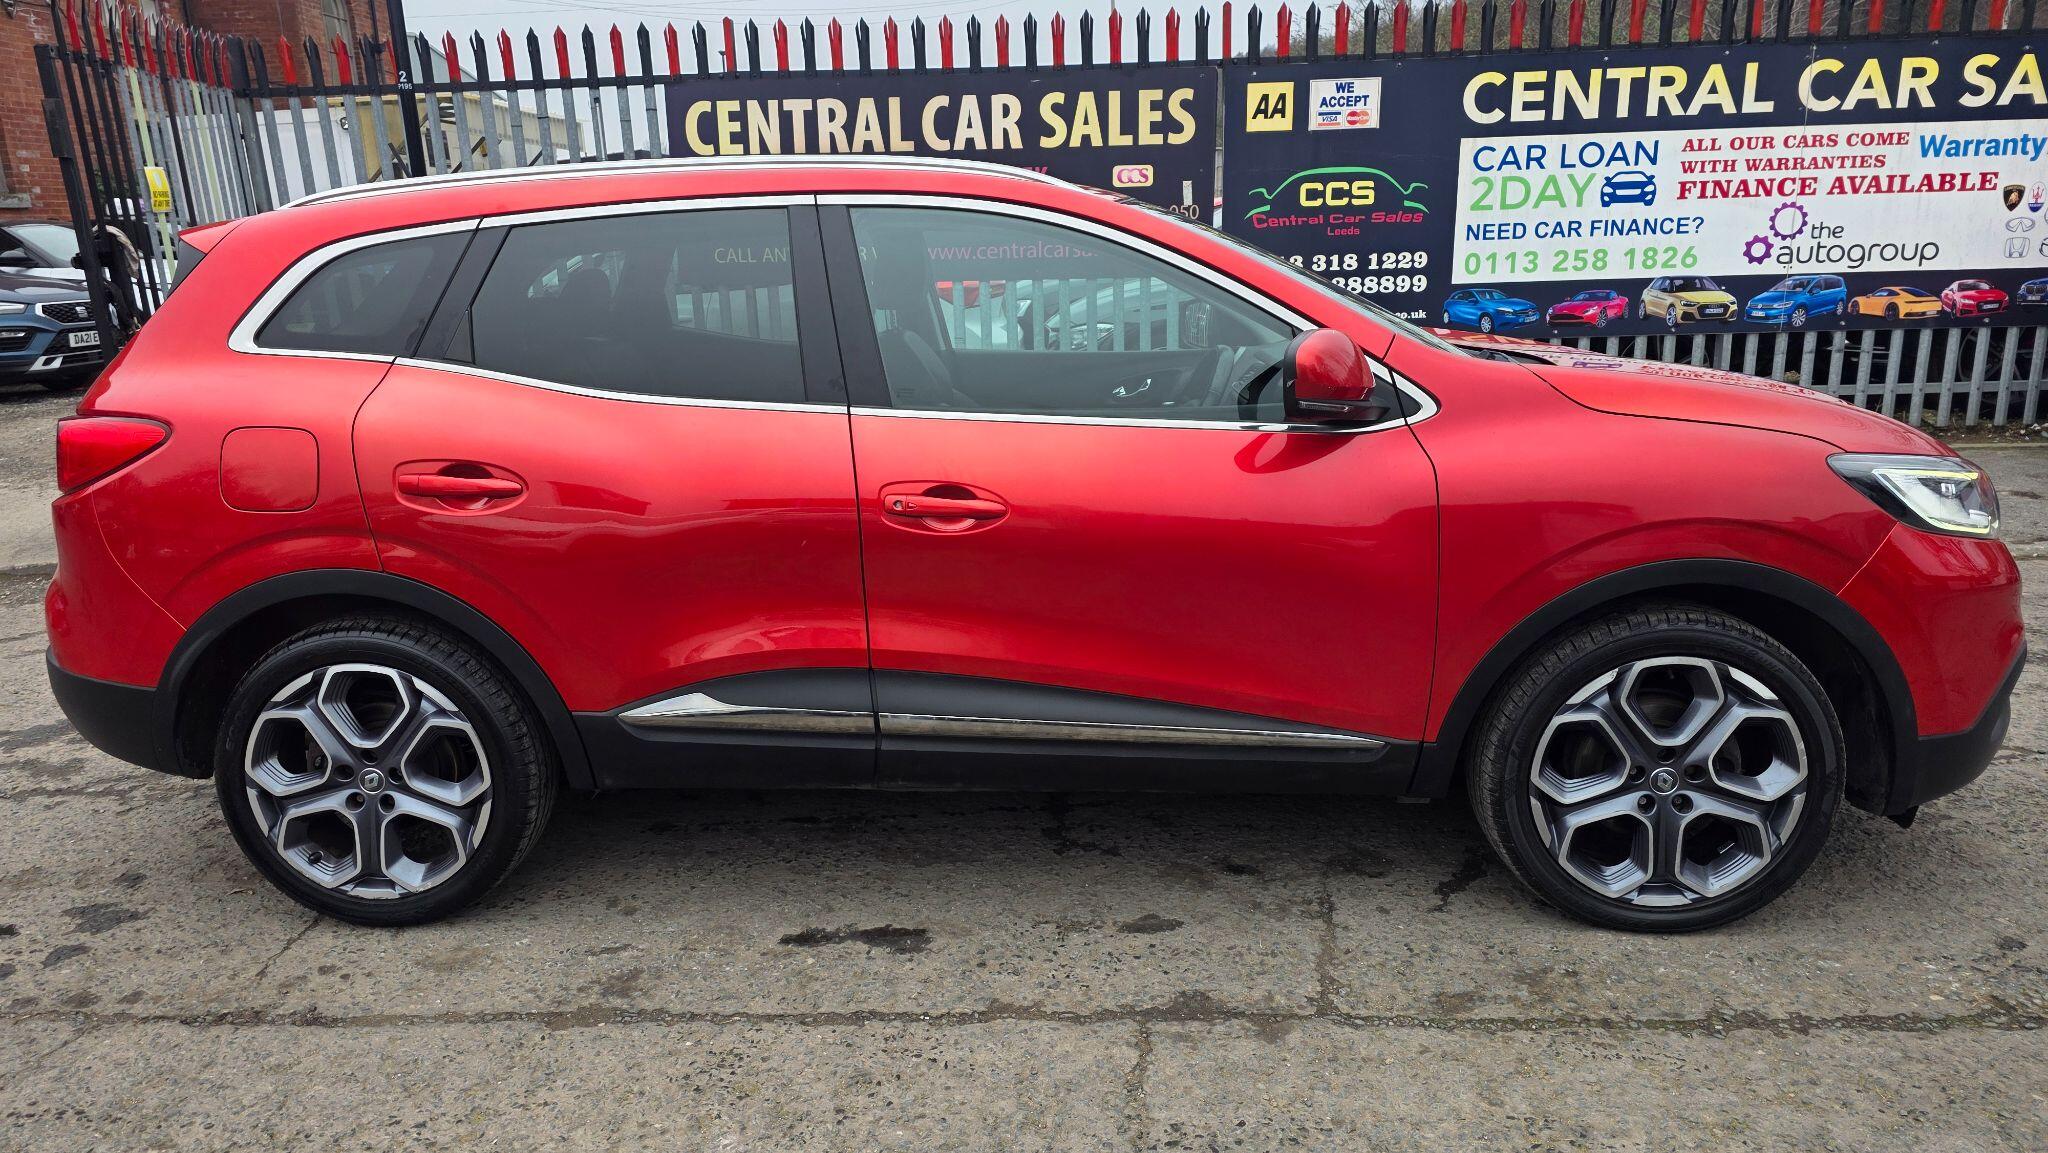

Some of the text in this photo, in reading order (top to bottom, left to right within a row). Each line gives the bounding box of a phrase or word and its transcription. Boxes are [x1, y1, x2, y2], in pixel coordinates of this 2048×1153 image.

[398, 70, 407, 82] 2
[1335, 82, 1354, 93] WE
[1463, 62, 1775, 124] CENTRAL
[1798, 56, 1939, 112] CAR
[1252, 92, 1287, 119] AA
[1320, 95, 1370, 108] ACCEPT
[685, 88, 1196, 156] CENTRAL CAR SALES
[1681, 131, 1910, 152] ALL OUR CARS COME
[1472, 140, 1659, 172] CAR LOAN
[1680, 154, 1887, 174] WITH WARRANTIES
[1299, 180, 1375, 207] CCS
[1469, 172, 1598, 212] 2DAY
[1676, 172, 1999, 200] FINANCE AVAILABLE
[1252, 211, 1424, 229] Central Car Sales
[1466, 216, 1705, 241] NEED CAR FINANCE?
[1811, 221, 1845, 239] the
[1327, 227, 1361, 236] Leeds
[714, 247, 790, 263] CALL AN
[1312, 253, 1358, 271] 318
[1368, 251, 1428, 270] 1229
[1464, 246, 1698, 275] 0113 258 1826
[1776, 240, 1940, 269] autogroup
[73, 333, 92, 344] DA21
